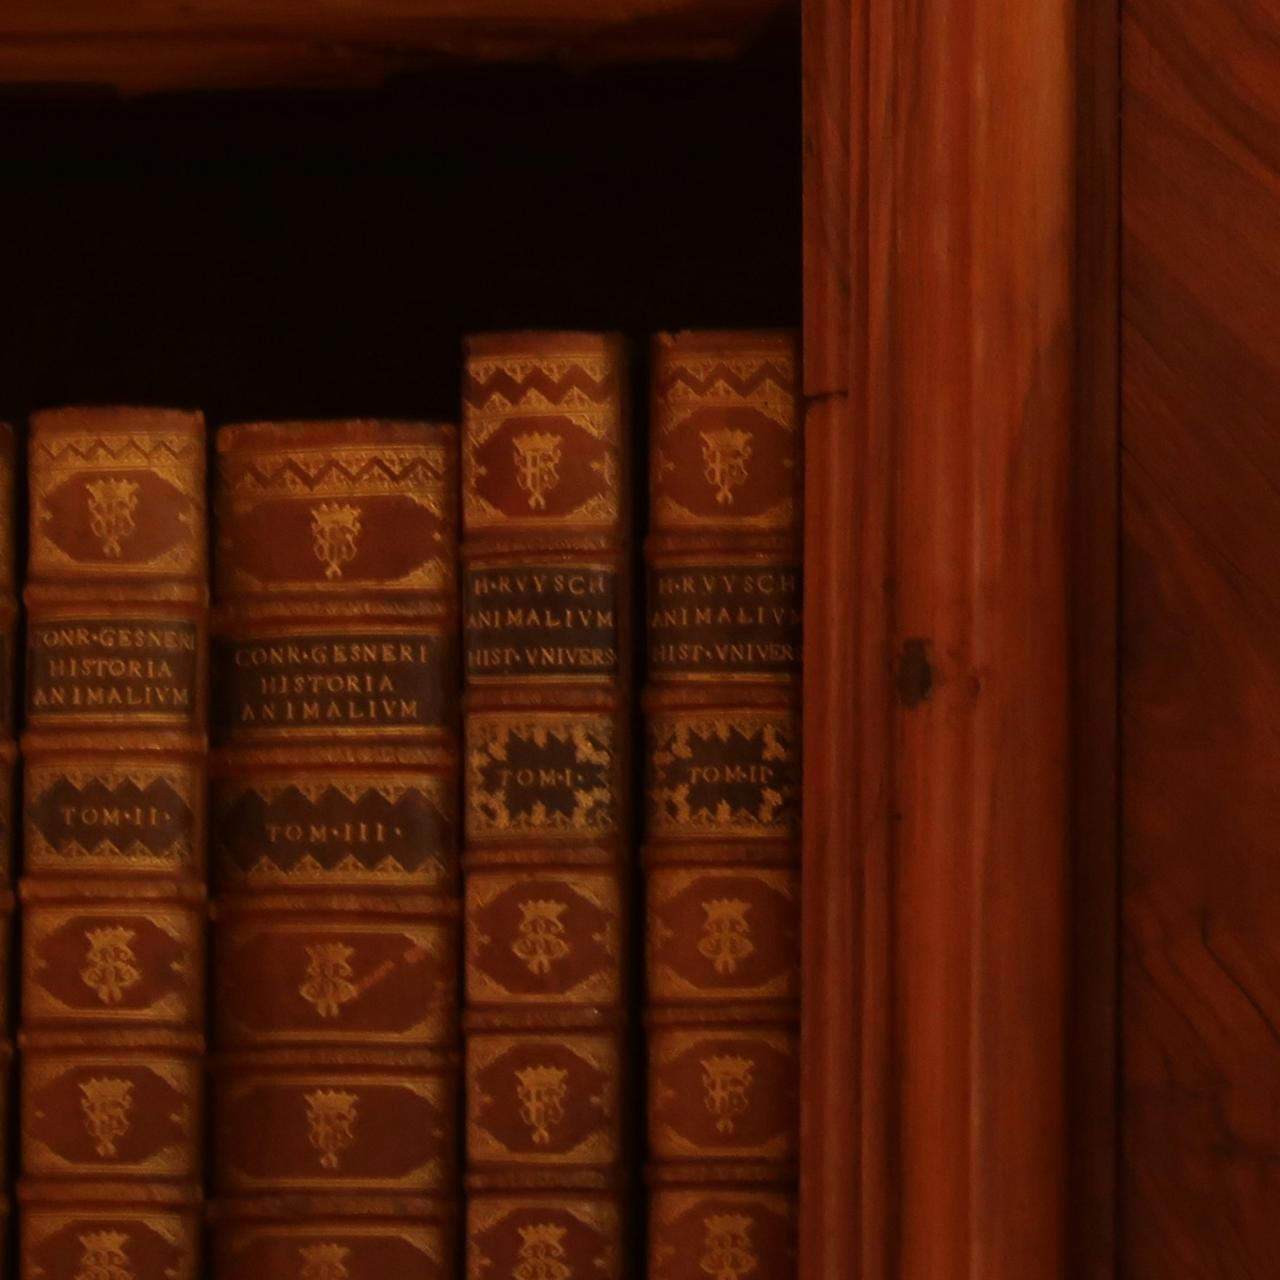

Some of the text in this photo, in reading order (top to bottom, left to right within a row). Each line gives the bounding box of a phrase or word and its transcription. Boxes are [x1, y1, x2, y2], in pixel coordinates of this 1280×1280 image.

[467, 608, 613, 628] ANIMALIVM
[49, 658, 173, 677] HISTORIA
[261, 674, 395, 695] HISTORIA
[33, 686, 190, 706] ANIMALIVM
[242, 700, 419, 721] ANIMALIVM
